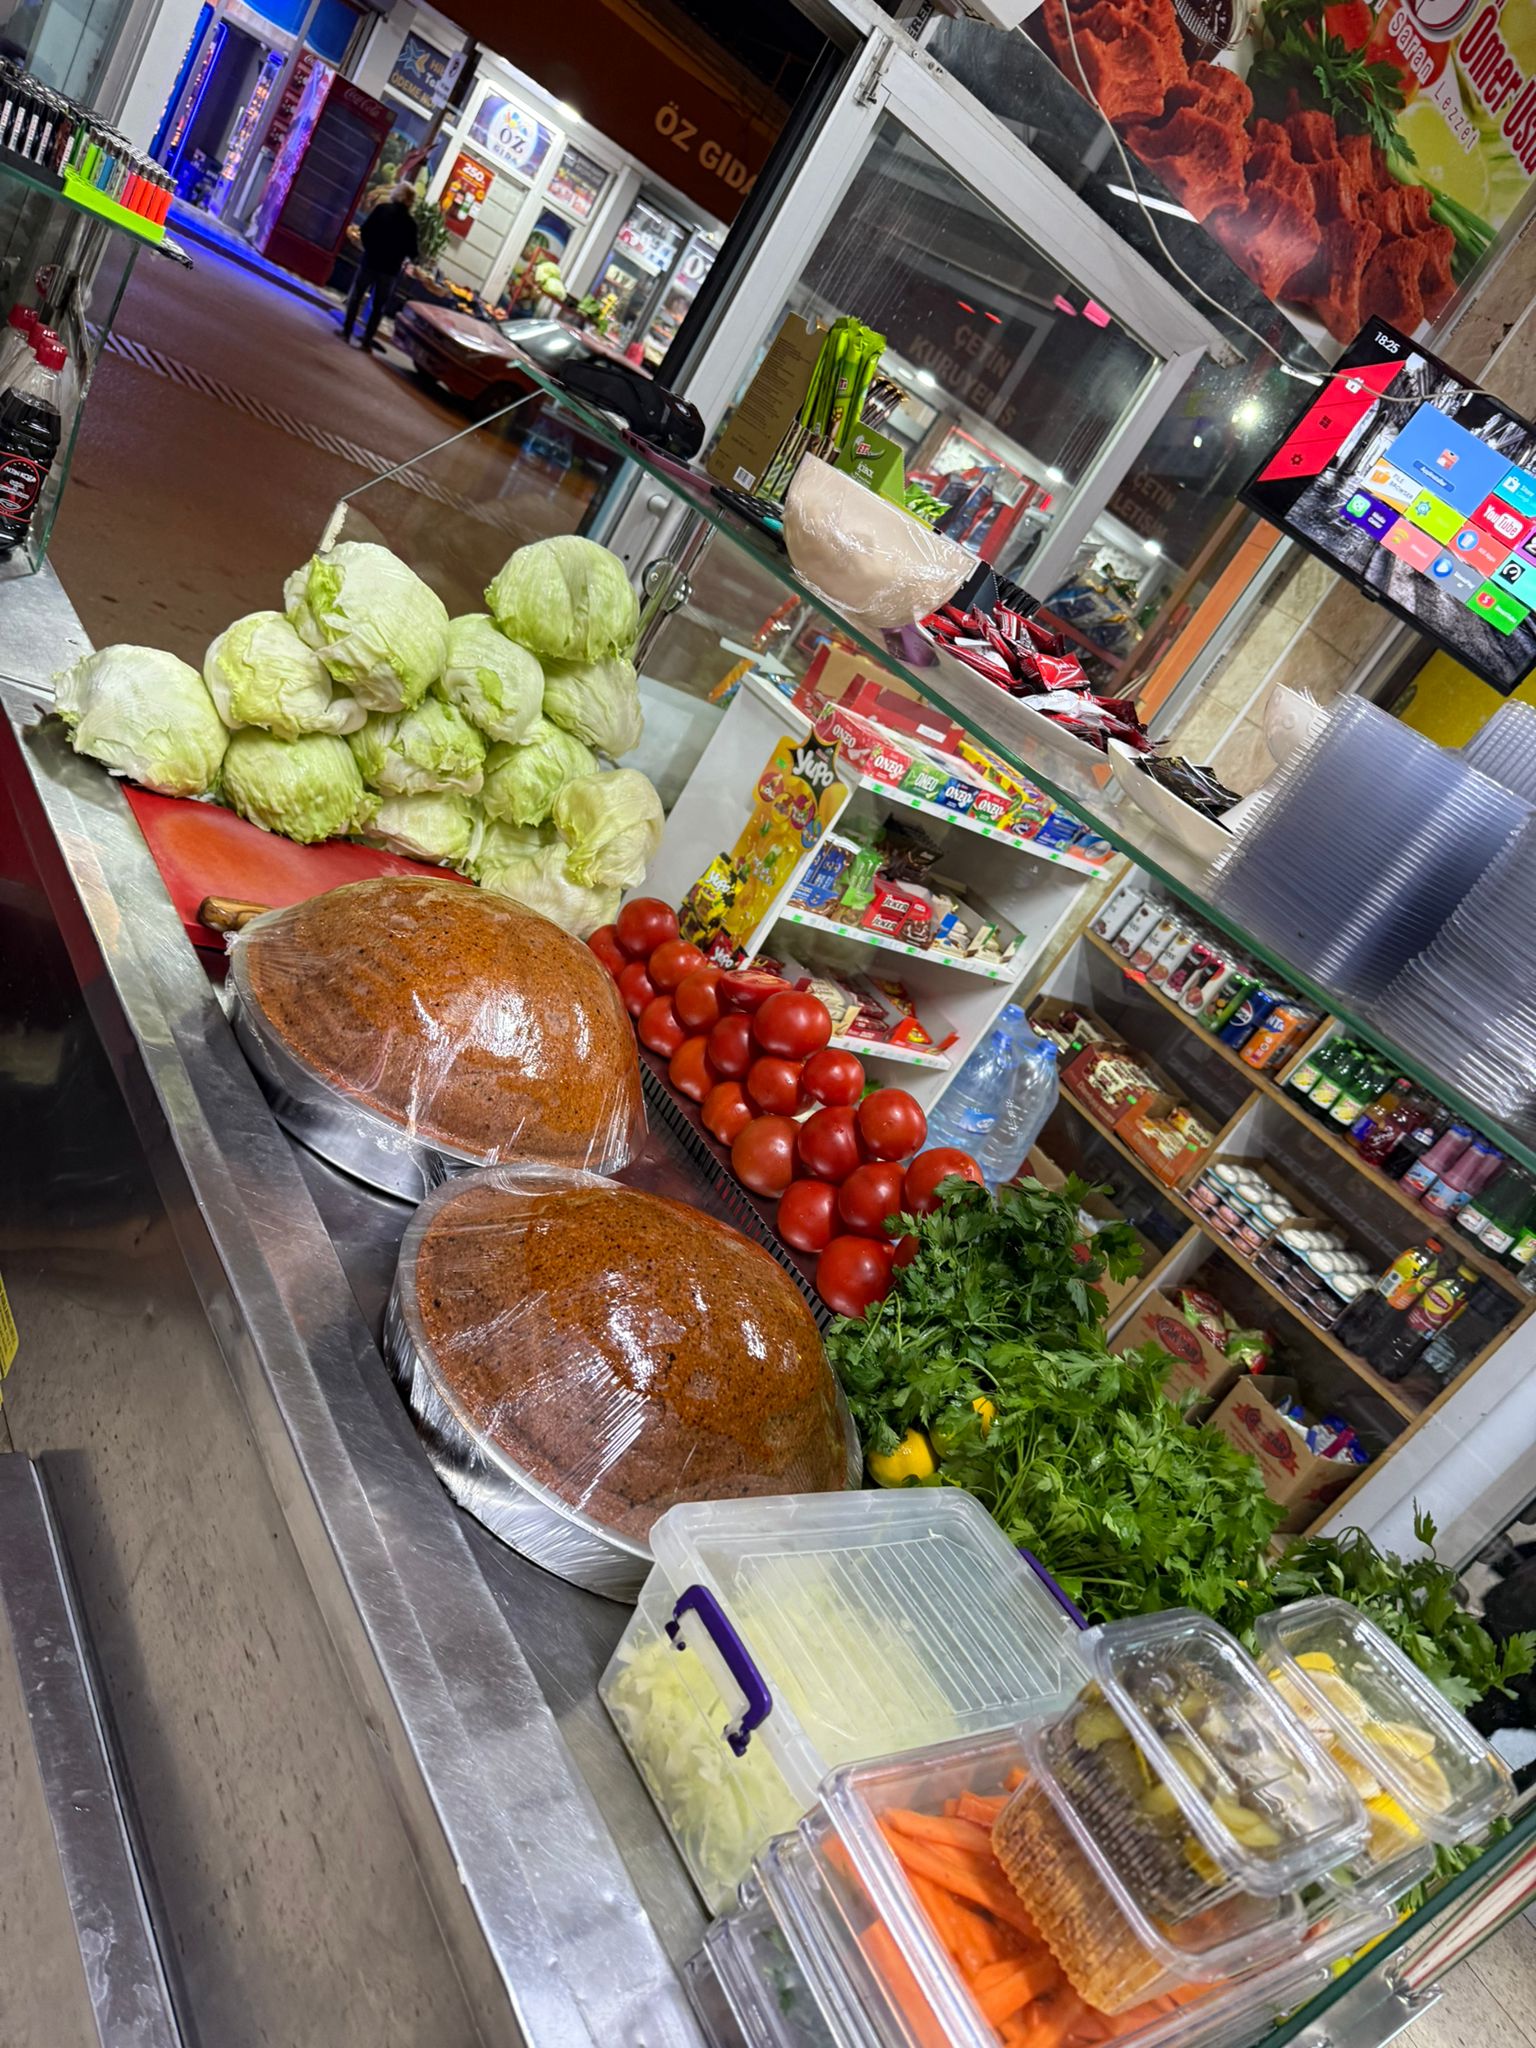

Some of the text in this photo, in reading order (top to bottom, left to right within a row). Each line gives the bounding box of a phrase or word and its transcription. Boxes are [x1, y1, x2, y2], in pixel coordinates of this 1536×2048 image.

[1391, 11, 1434, 80] Saran
[655, 101, 699, 153] ÖZ
[1434, 81, 1478, 149] Lezzet
[1483, 504, 1519, 536] YouTube
[832, 724, 856, 748] ONEO
[874, 755, 904, 778] ONEO
[914, 772, 939, 792] ONEO
[945, 785, 974, 806] ONEO
[979, 799, 1005, 821] ONEO
